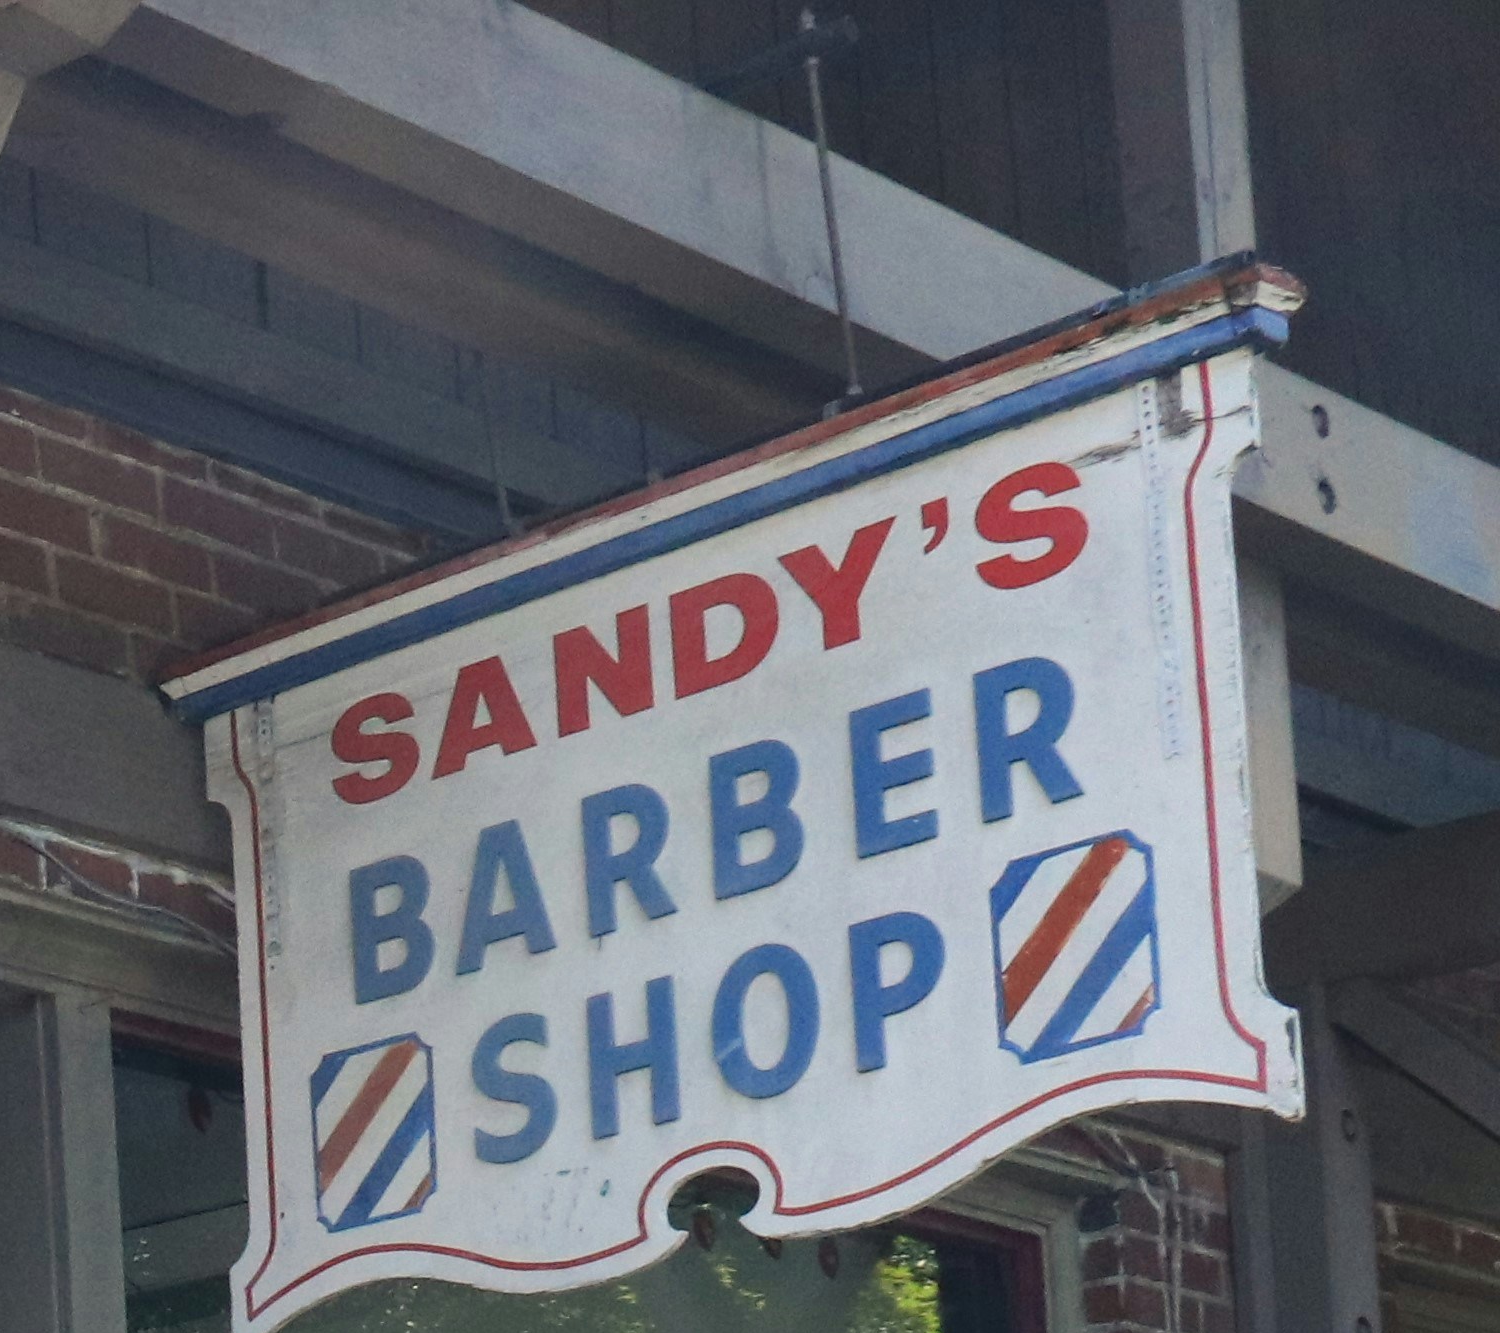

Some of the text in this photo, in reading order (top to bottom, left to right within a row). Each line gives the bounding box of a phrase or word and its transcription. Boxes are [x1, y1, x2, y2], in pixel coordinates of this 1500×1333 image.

[330, 460, 1089, 805] SANDY'S
[348, 655, 1087, 1005] BARBER
[471, 910, 946, 1165] SHOP
